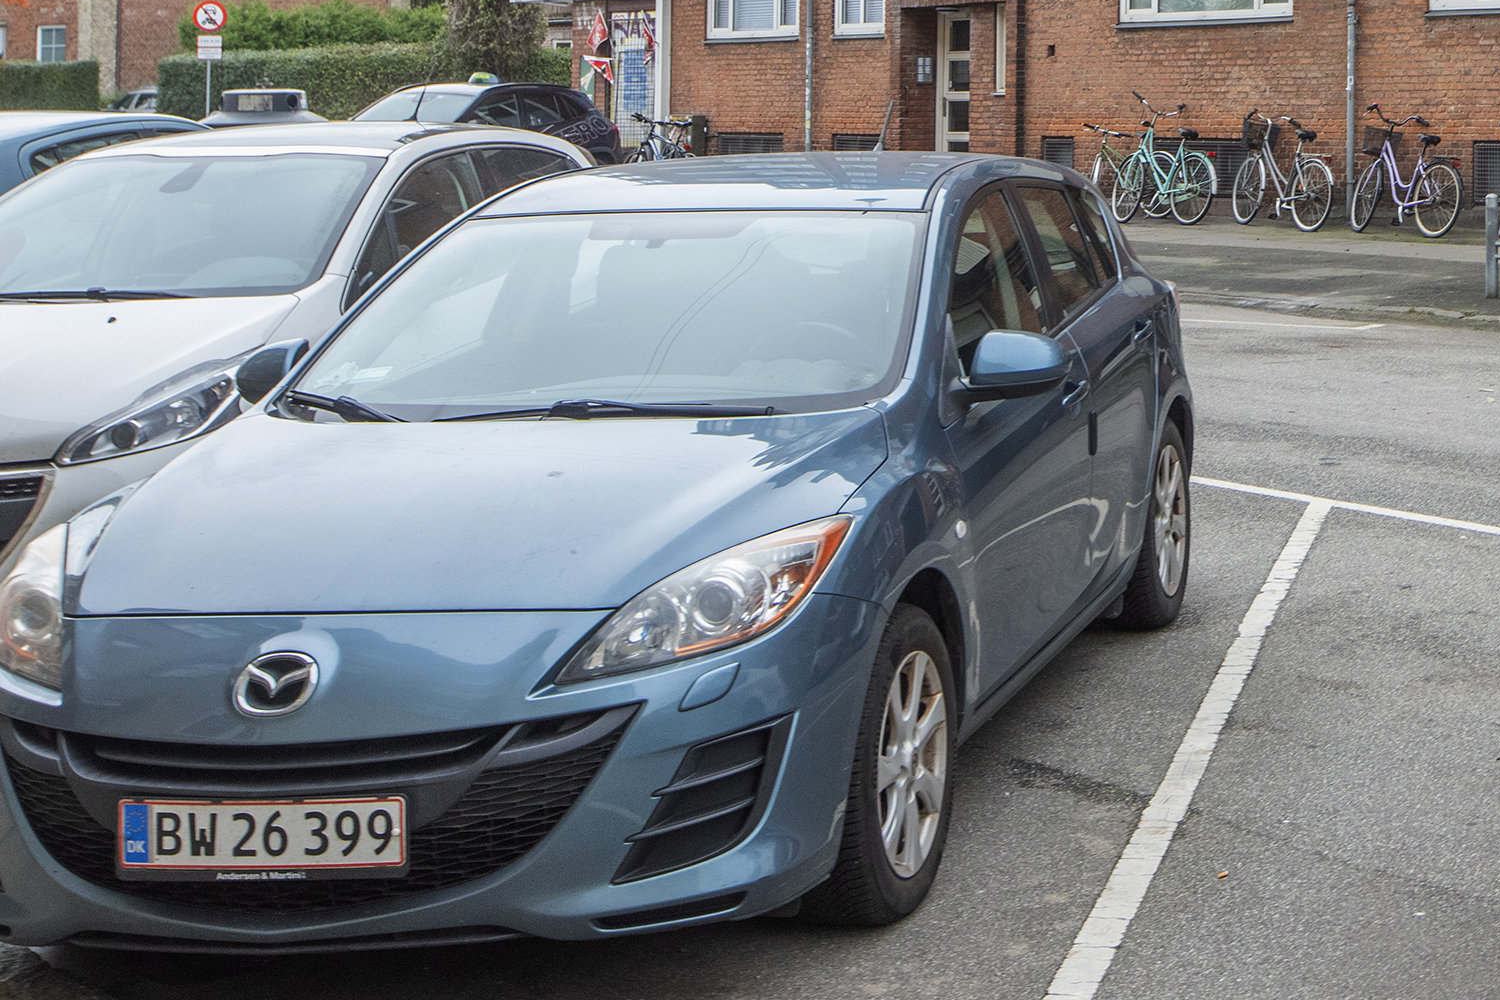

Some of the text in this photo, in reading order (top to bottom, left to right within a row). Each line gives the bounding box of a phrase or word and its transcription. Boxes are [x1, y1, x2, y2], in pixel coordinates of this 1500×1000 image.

[156, 808, 394, 858] BW 26 399
[126, 840, 146, 854] DK
[216, 872, 260, 880] Andersen
